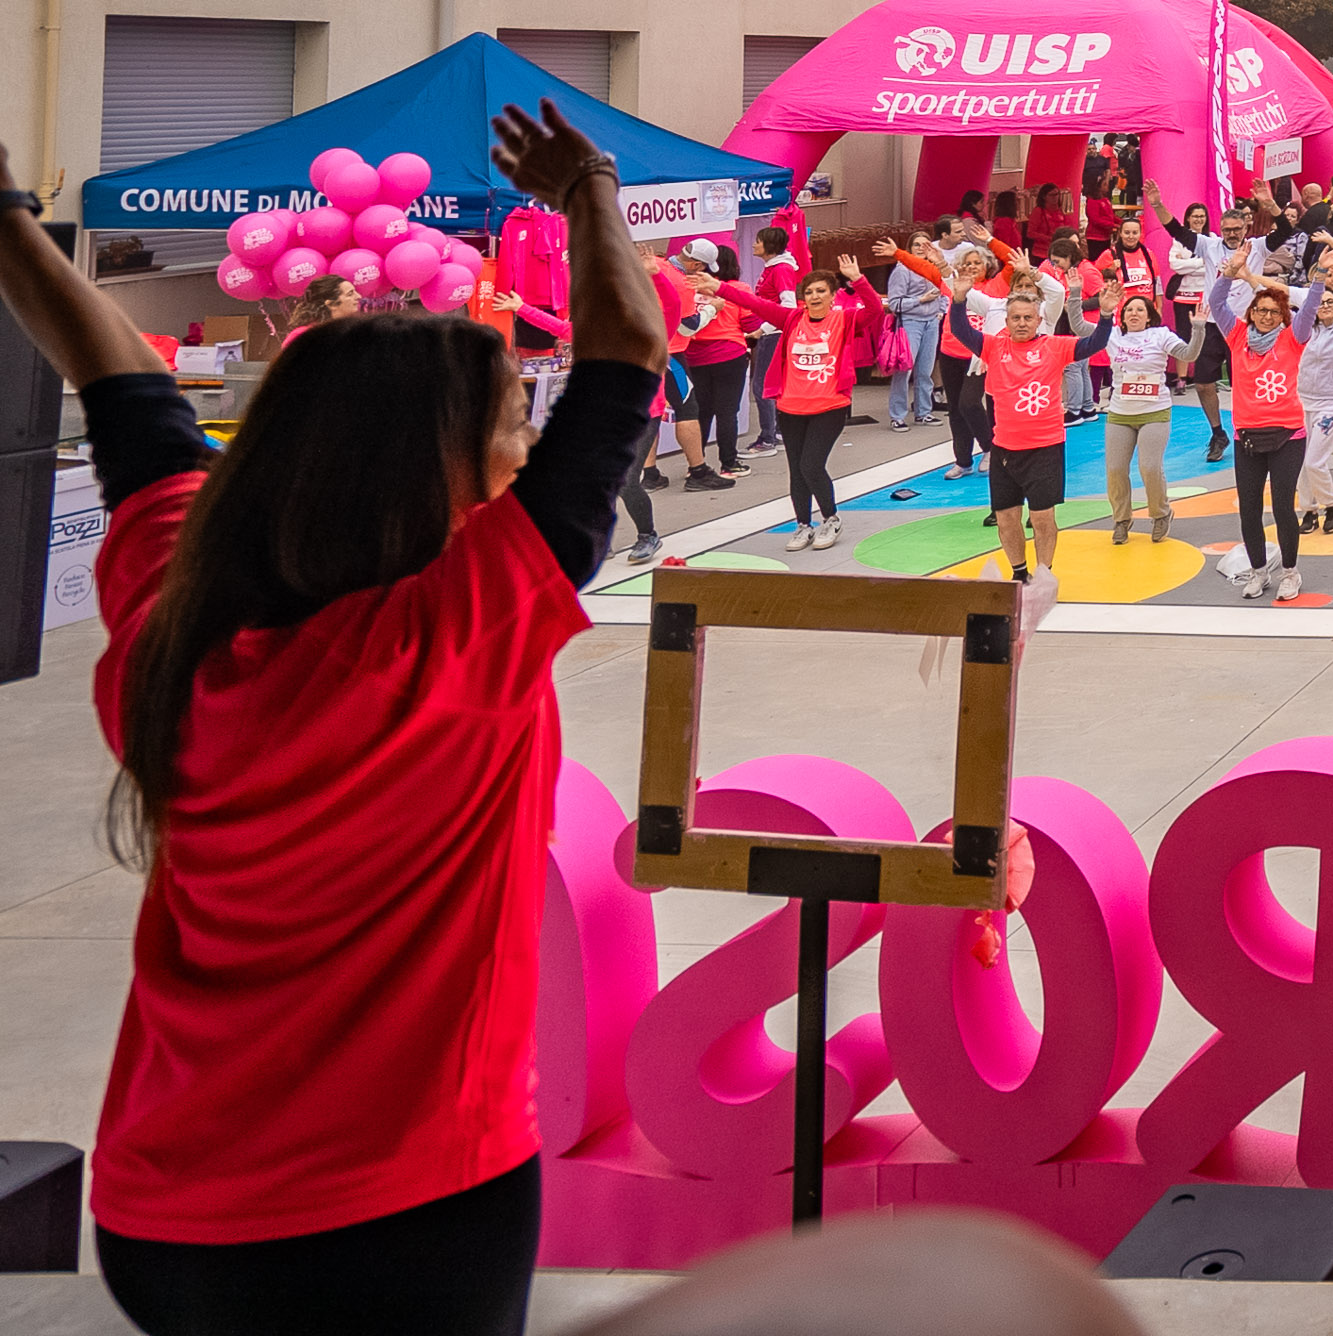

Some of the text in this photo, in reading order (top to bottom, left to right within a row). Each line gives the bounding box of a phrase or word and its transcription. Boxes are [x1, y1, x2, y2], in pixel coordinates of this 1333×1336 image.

[961, 32, 1112, 76] UISP
[871, 83, 1101, 125] sportpertutti
[120, 188, 250, 213] COMUNE
[626, 197, 698, 226] GADGET
[798, 354, 822, 365] 619
[1127, 384, 1153, 394] 298
